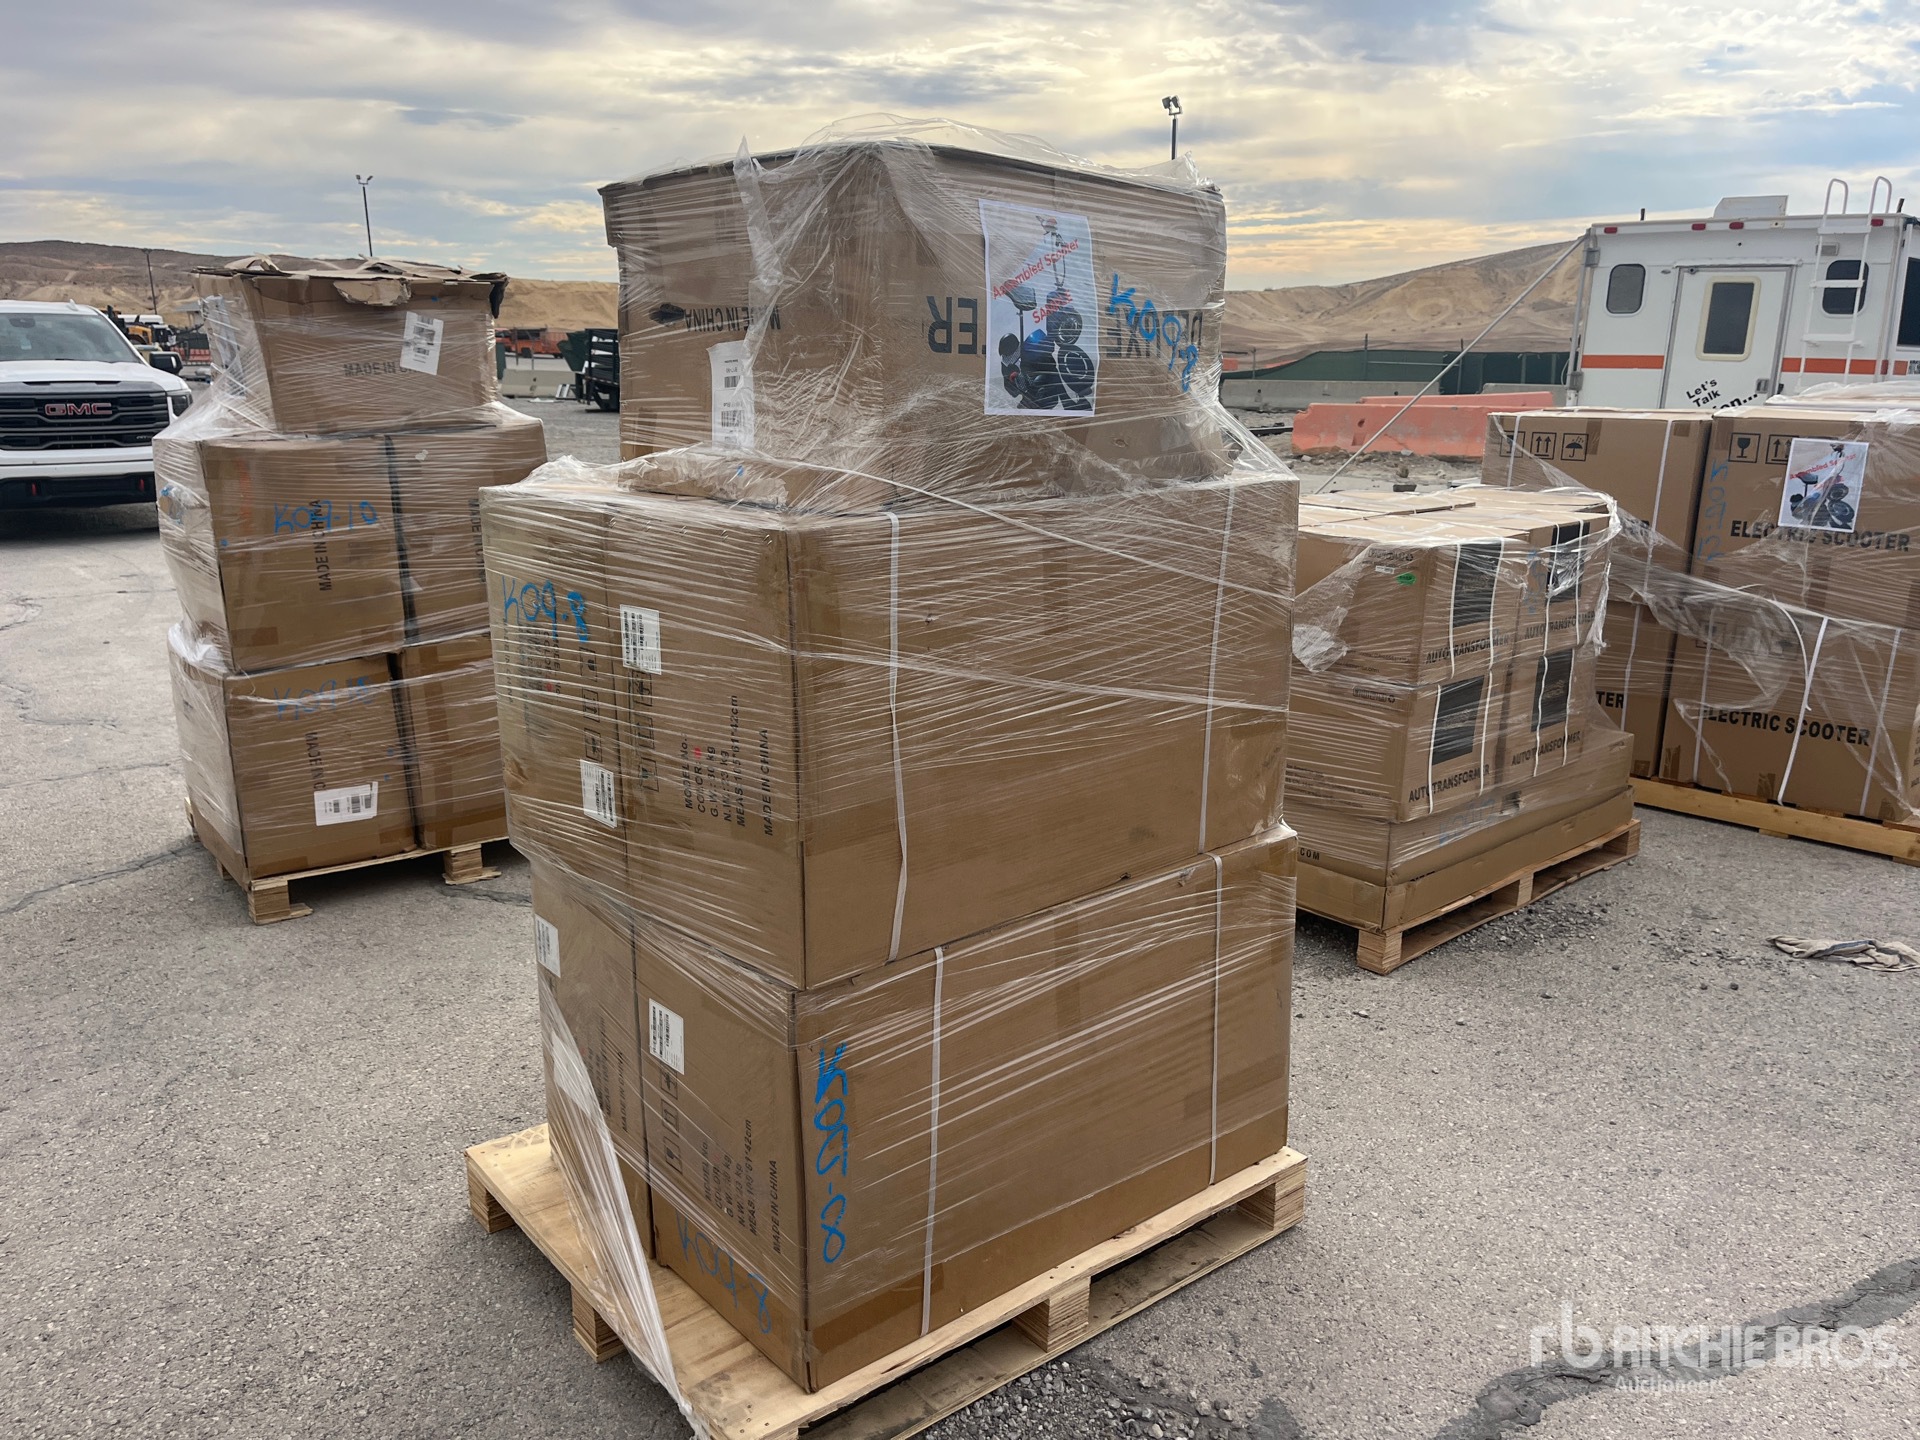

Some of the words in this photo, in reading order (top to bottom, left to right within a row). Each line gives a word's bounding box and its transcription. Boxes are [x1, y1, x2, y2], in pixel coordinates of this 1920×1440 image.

[683, 307, 724, 332] CHINA
[727, 306, 740, 331] IN
[742, 305, 781, 331] ME
[343, 361, 380, 377] MADE
[383, 361, 396, 374] IN
[1686, 379, 1718, 400] Let's
[1692, 390, 1721, 408] Talk
[44, 402, 113, 416] GMC
[309, 499, 325, 539] CHINA
[313, 541, 327, 554] IN
[1822, 529, 1911, 552] SCOOTER
[315, 555, 332, 591] MADE
[1784, 716, 1872, 747] SCOOTER
[759, 729, 770, 775] CHINA
[681, 763, 694, 809] MODEL
[761, 777, 771, 793] IN
[1408, 764, 1490, 803] AUTOTRANSFORMR
[763, 795, 773, 836] MADE
[768, 1160, 779, 1201] CHINA
[770, 1202, 779, 1217] IN
[771, 1215, 782, 1254] MADE
